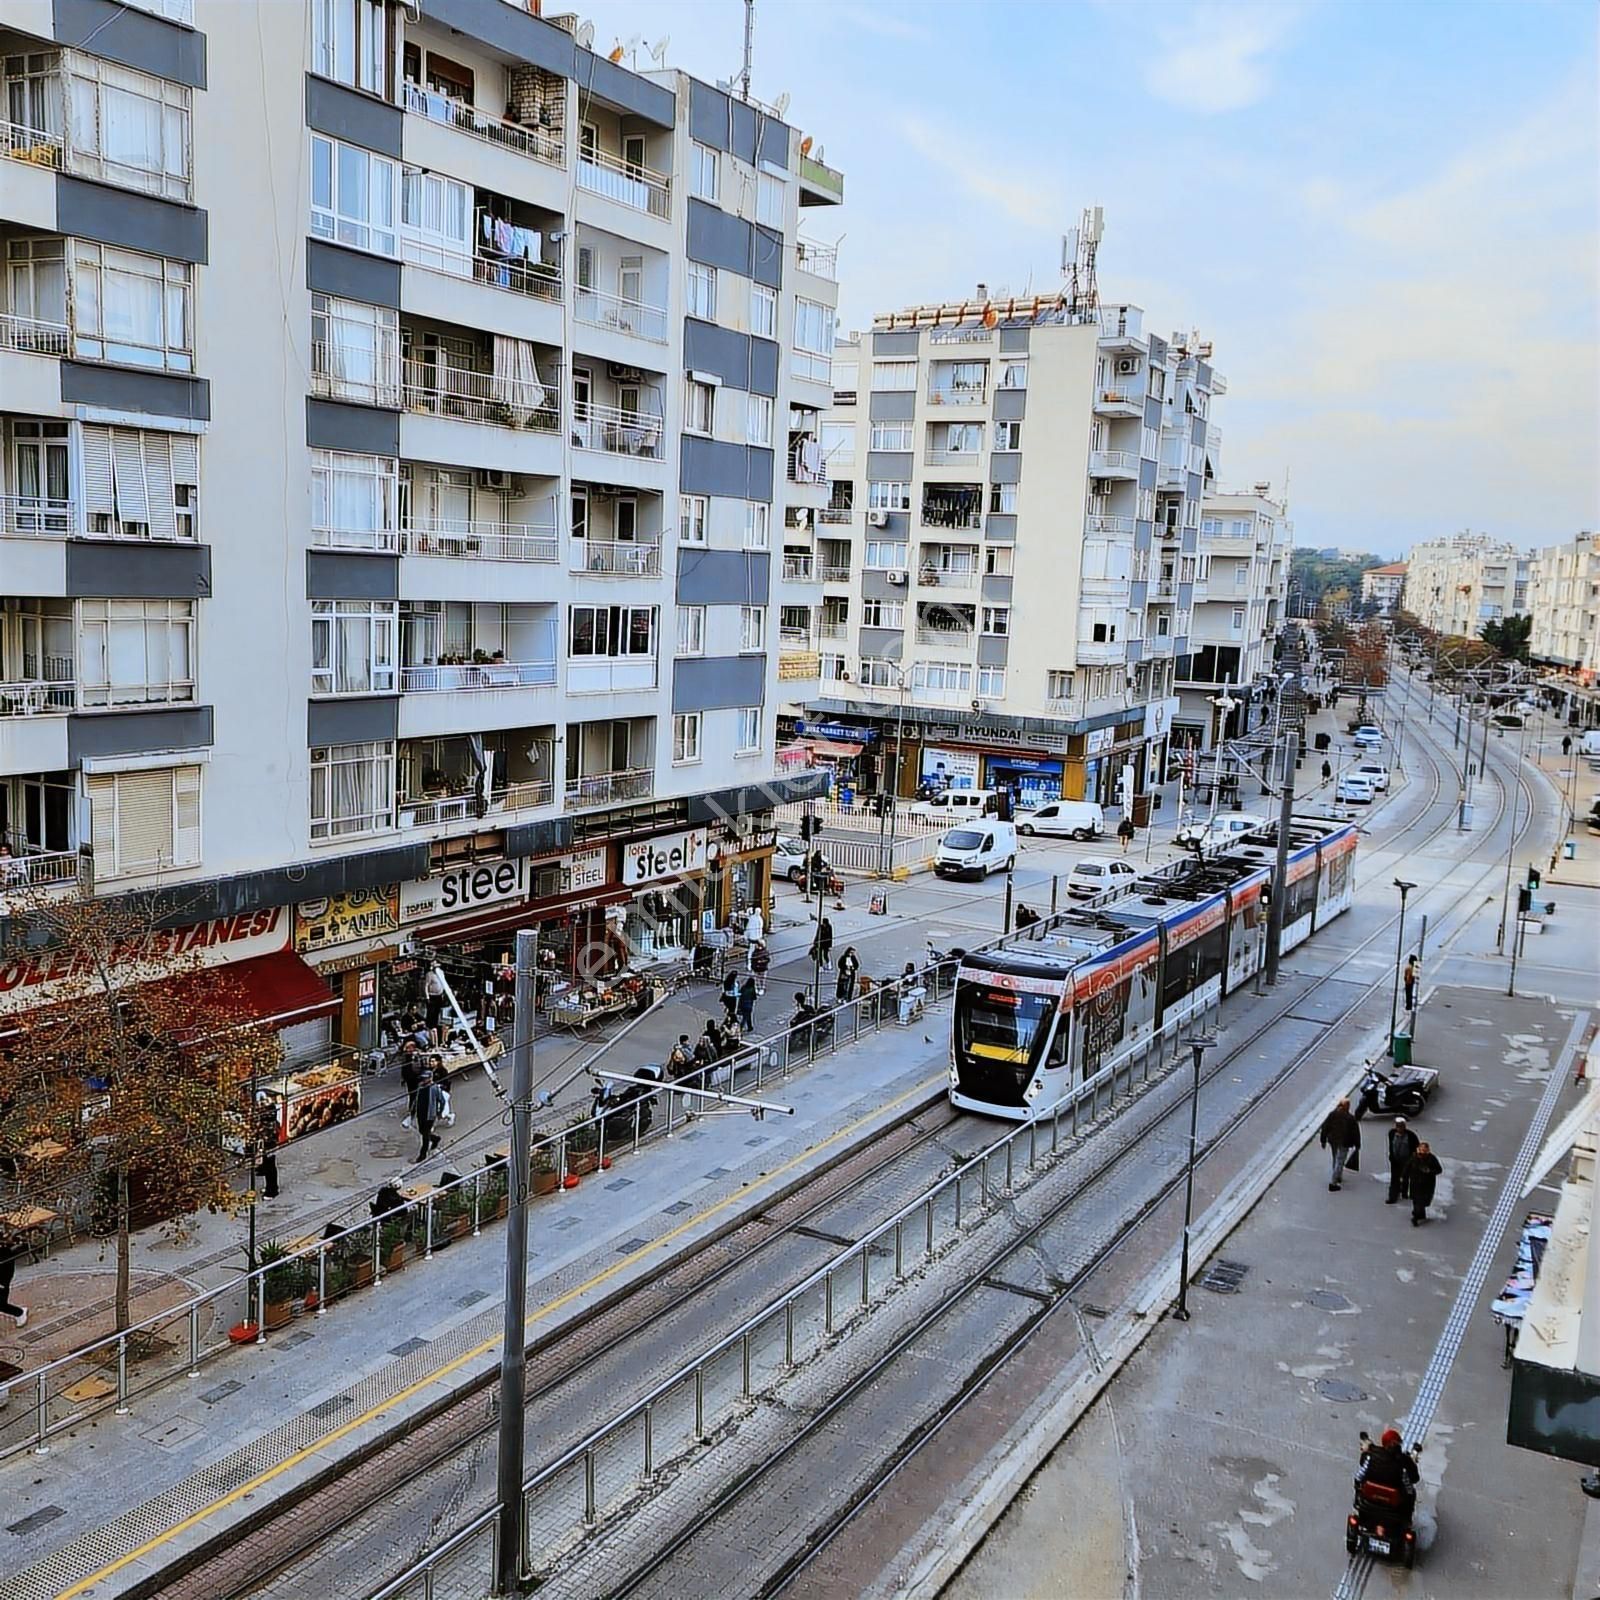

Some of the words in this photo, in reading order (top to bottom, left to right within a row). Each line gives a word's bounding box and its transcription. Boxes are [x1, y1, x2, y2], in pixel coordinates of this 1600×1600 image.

[965, 725, 1021, 740] HYUNDAI
[636, 837, 688, 879] steel
[441, 857, 523, 908] steel
[575, 868, 604, 886] STEEL
